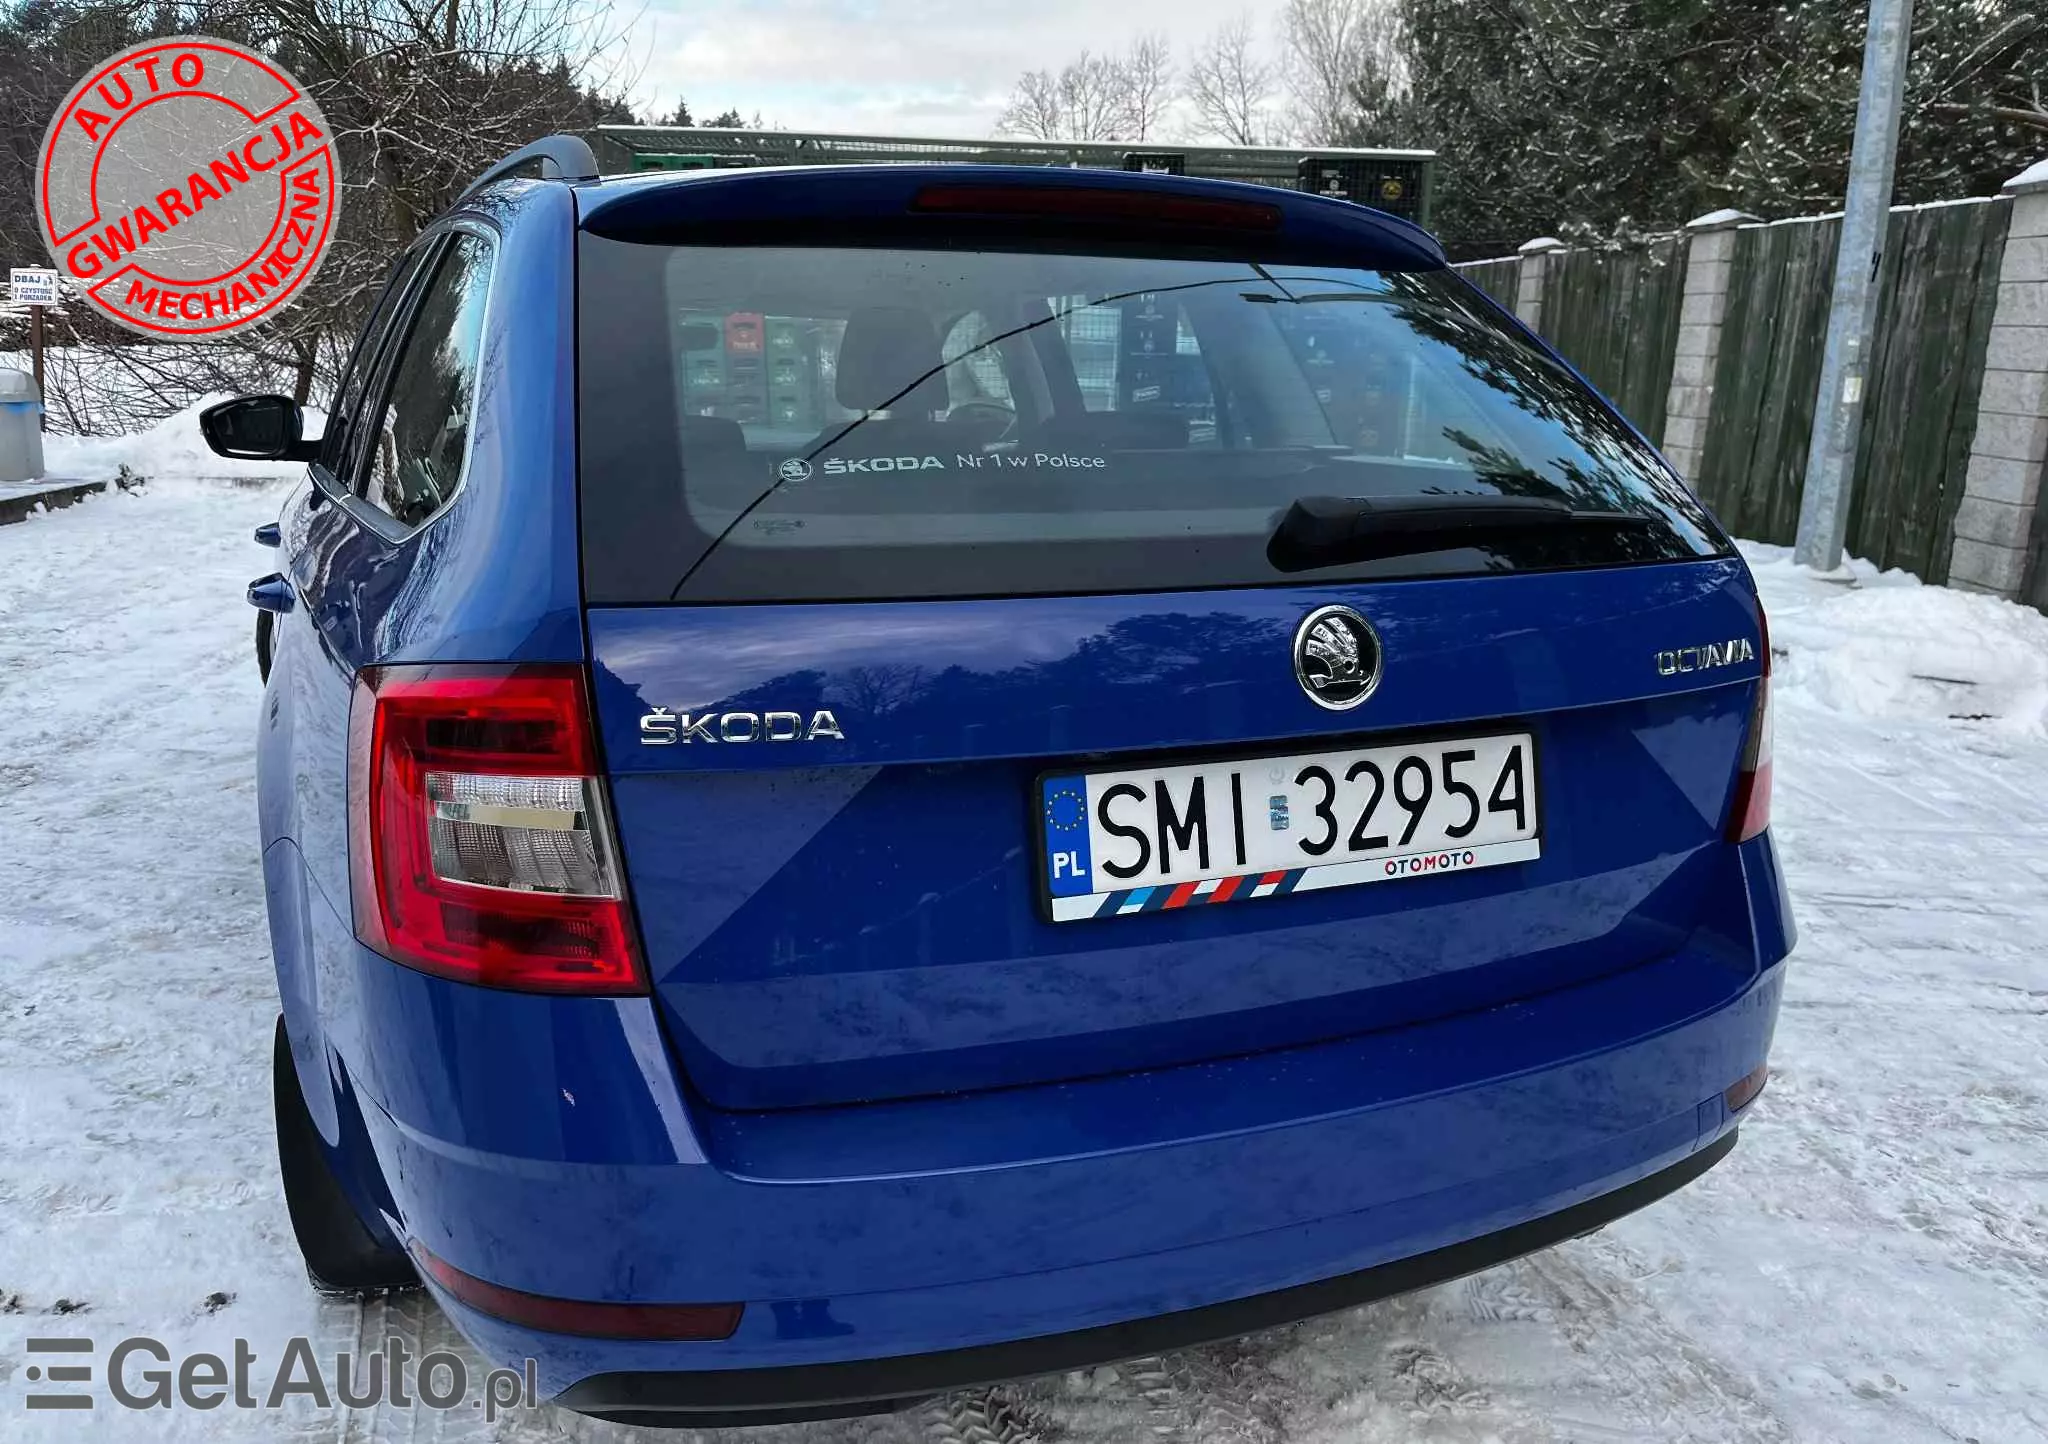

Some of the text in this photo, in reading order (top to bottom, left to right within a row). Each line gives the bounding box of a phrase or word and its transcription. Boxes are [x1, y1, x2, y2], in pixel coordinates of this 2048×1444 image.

[823, 453, 1106, 474] ŠKODA Nr 1 w Polsce
[1656, 638, 1754, 676] OCTAVIA
[640, 707, 845, 745] ŠKODA
[1097, 745, 1526, 879] SMI 32954
[1053, 851, 1086, 879] PL
[1385, 850, 1474, 876] OTOMOTO
